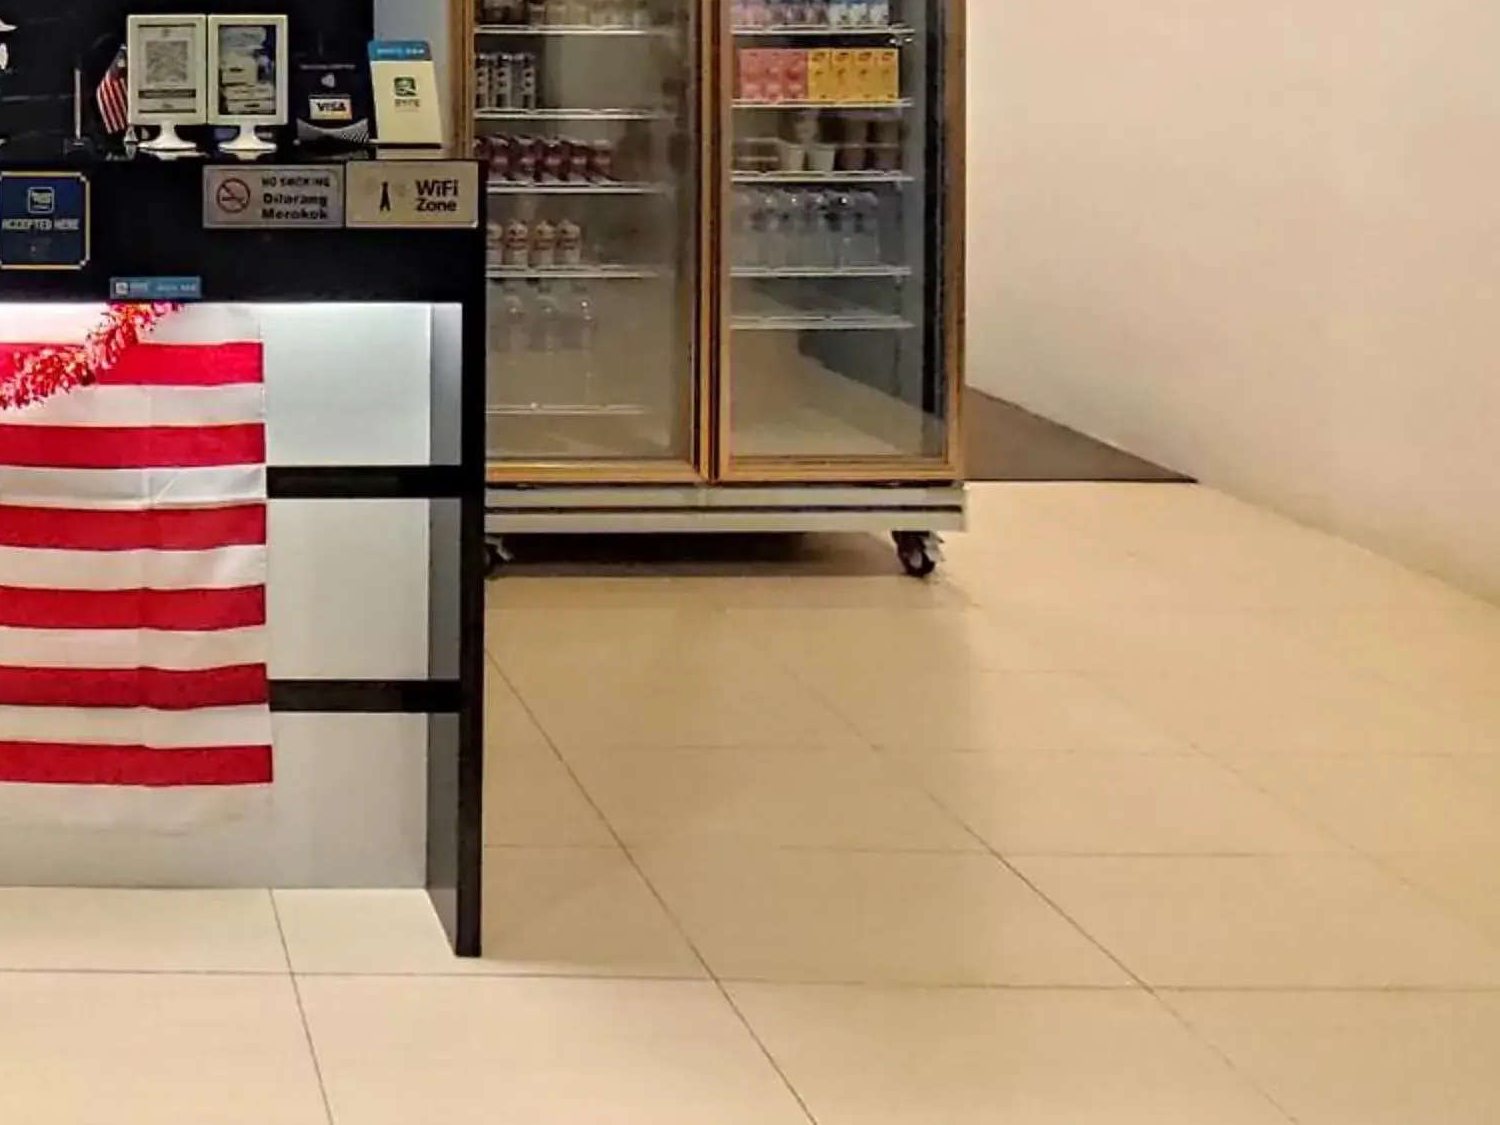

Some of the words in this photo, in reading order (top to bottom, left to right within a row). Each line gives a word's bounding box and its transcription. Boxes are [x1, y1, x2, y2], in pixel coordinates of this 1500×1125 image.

[316, 102, 347, 112] VISA
[415, 179, 459, 197] WiFi
[415, 198, 457, 213] Zone
[261, 208, 328, 220] Merokok
